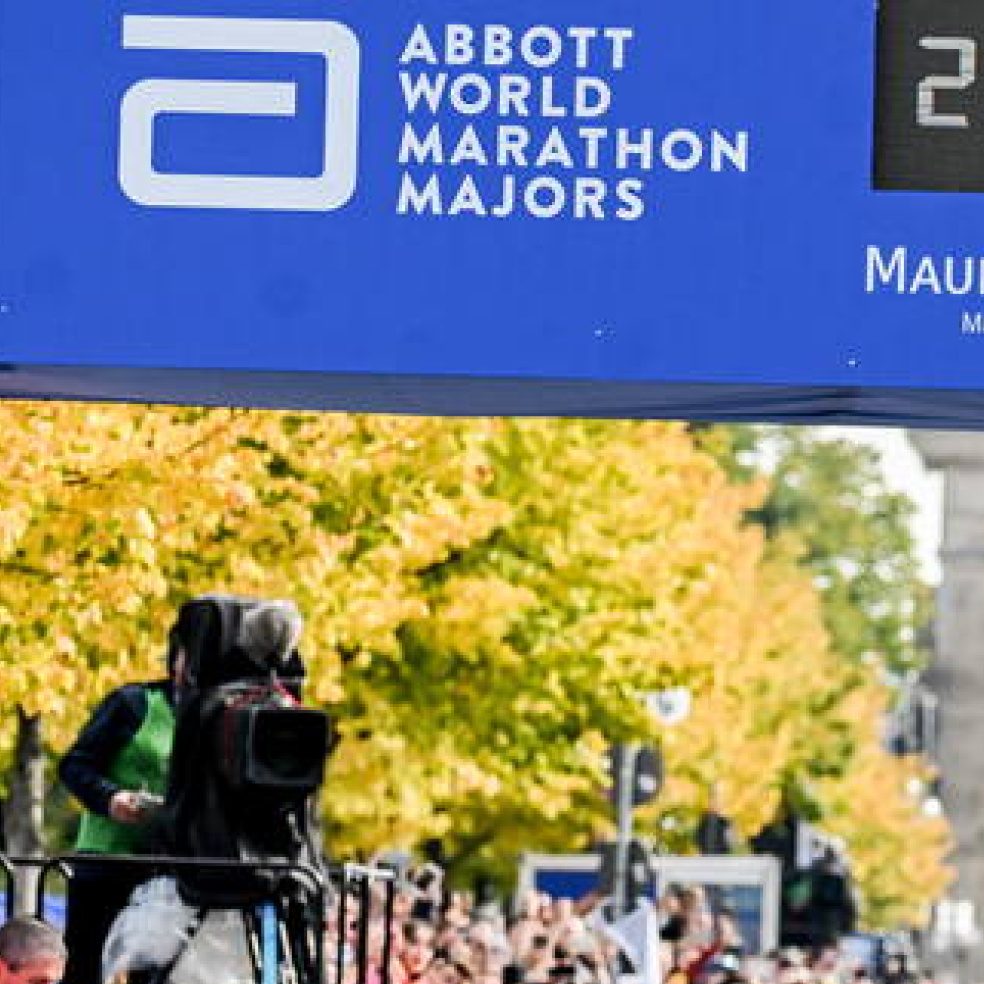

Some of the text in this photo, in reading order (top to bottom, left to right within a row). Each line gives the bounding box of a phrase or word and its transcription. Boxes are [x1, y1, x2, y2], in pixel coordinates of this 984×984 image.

[398, 24, 634, 69] ABBOTT
[398, 73, 612, 118] WORLD
[398, 124, 750, 173] MARATHON
[396, 174, 646, 221] MAJORS
